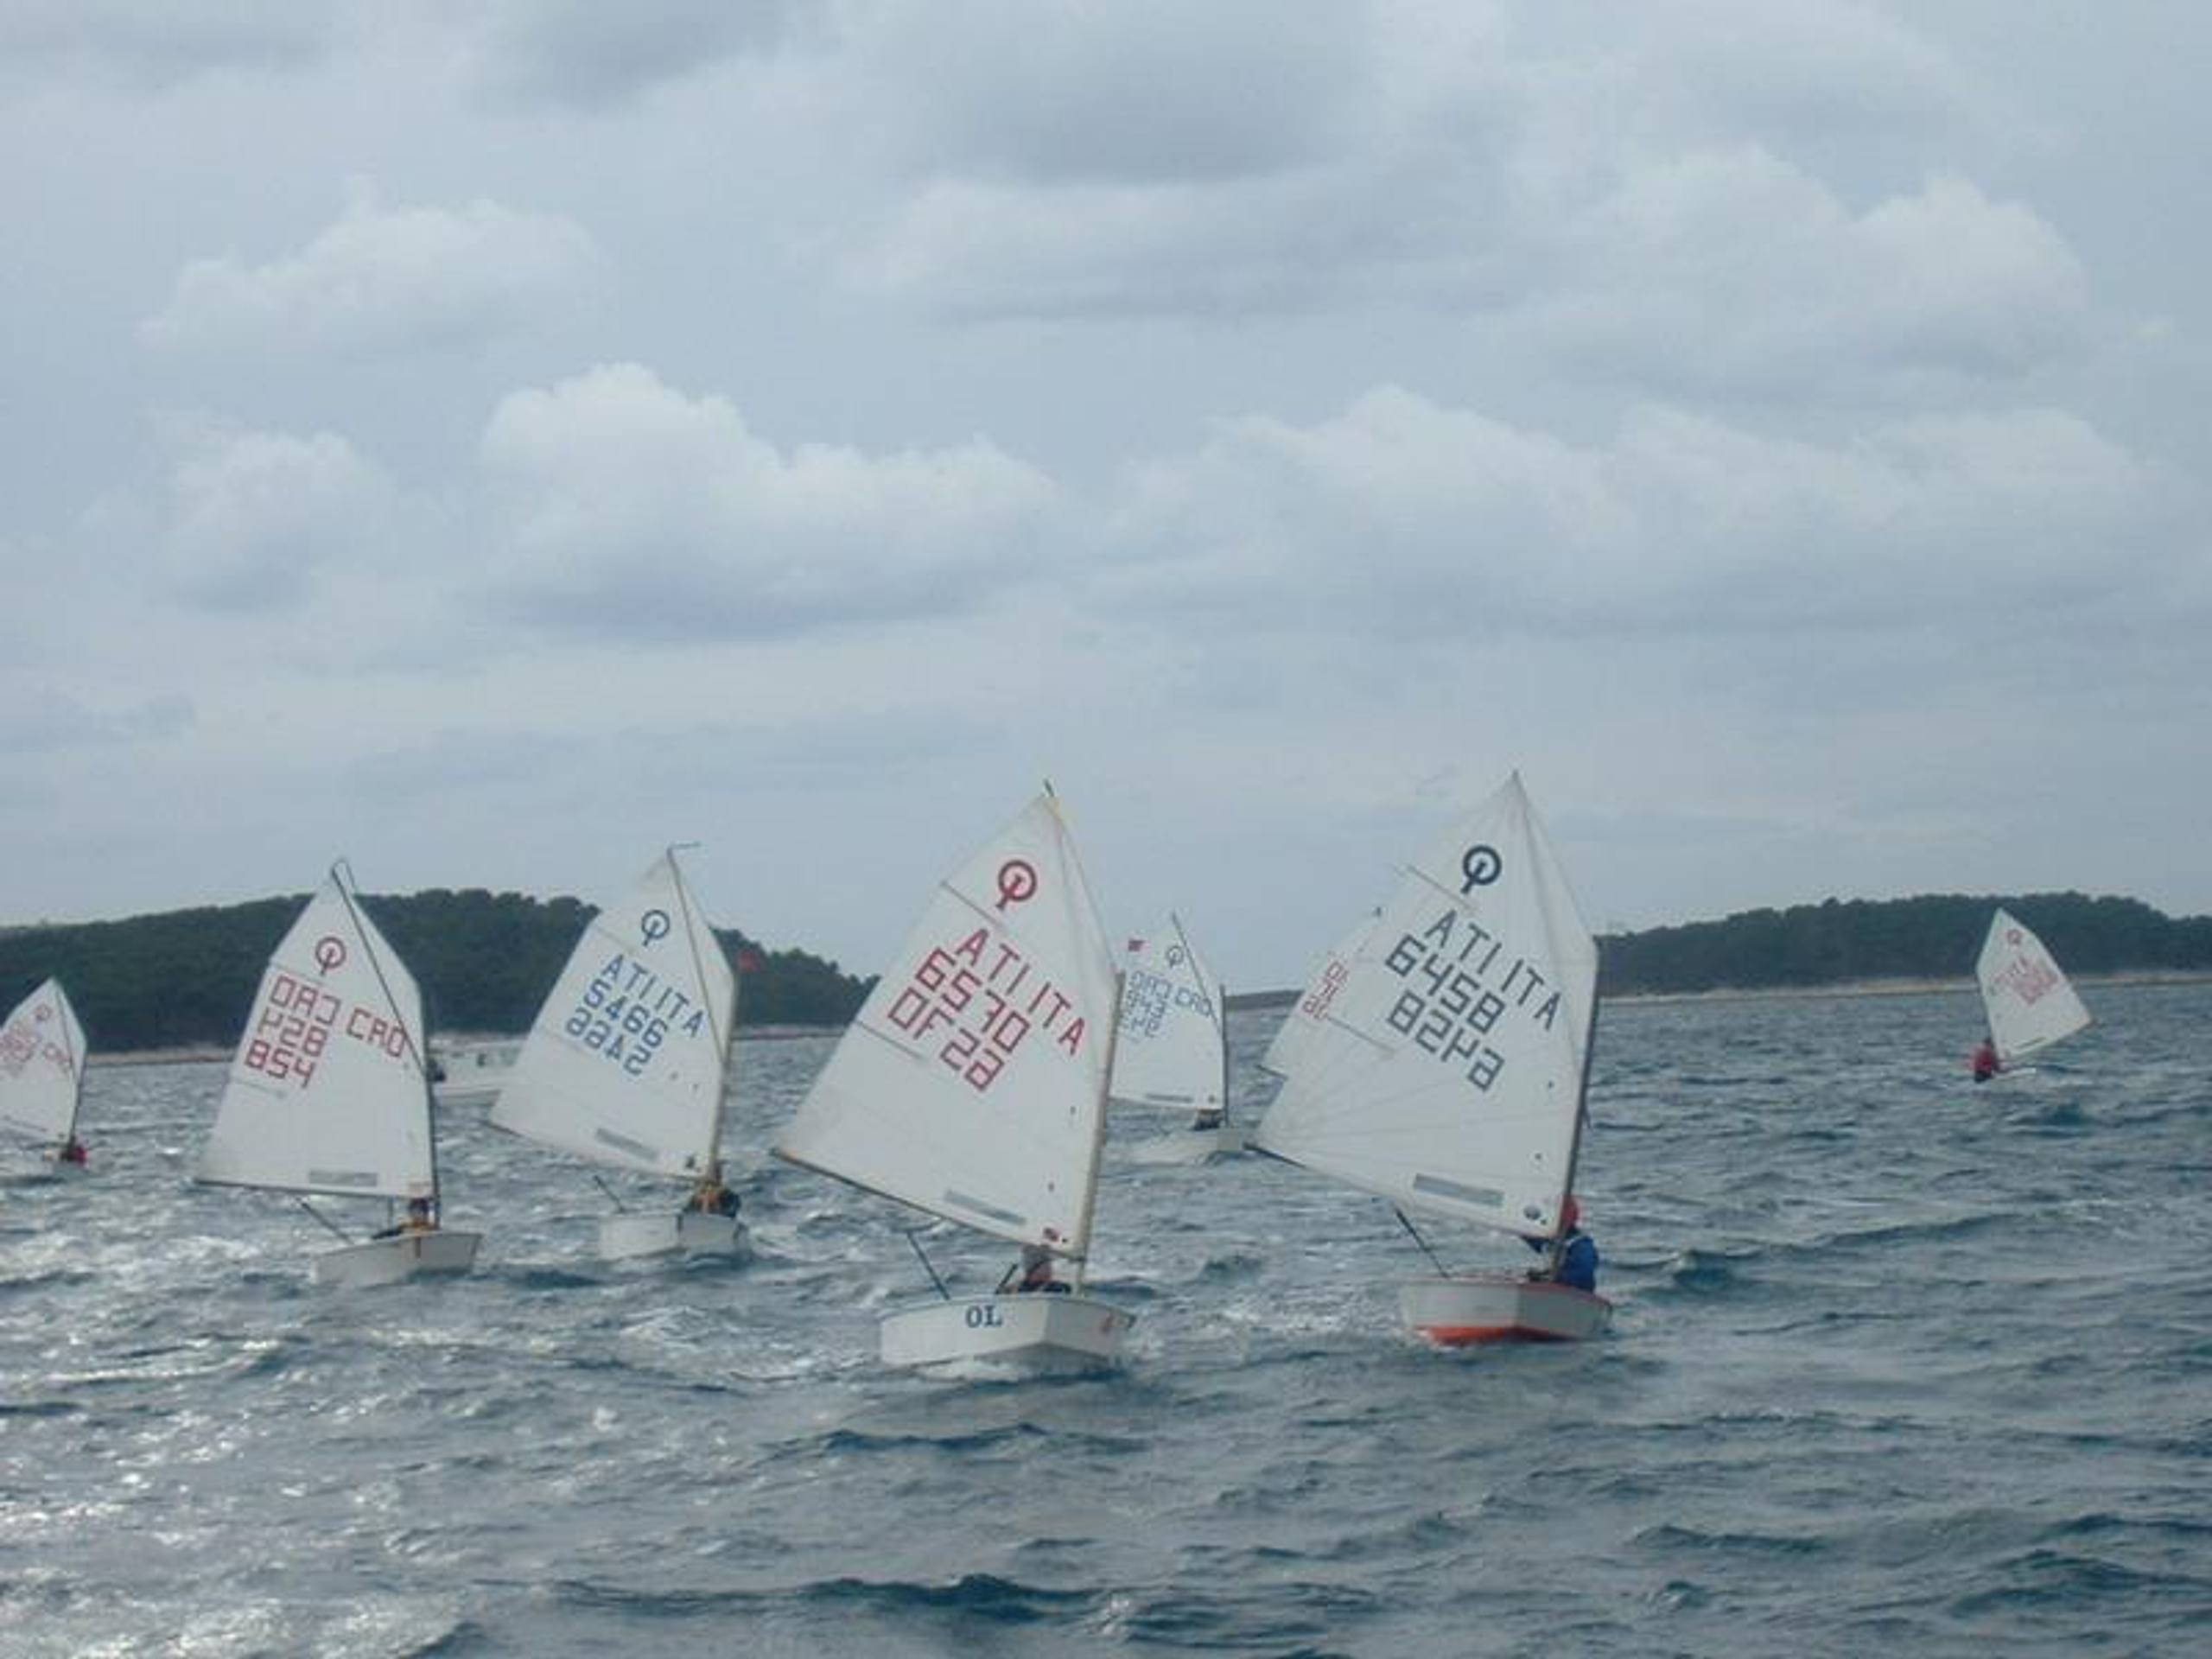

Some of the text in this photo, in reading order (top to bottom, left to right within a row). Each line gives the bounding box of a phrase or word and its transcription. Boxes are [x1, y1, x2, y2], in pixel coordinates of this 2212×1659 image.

[583, 978, 670, 1048] 5466
[654, 987, 703, 1037] ITA
[916, 947, 1031, 1053] 6570
[1027, 982, 1086, 1056] ITA
[1385, 933, 1506, 1035] 6458
[1500, 958, 1561, 1032] ITA
[244, 1039, 316, 1089] 854
[346, 1007, 406, 1058] CRO
[964, 1305, 1003, 1329] OL
